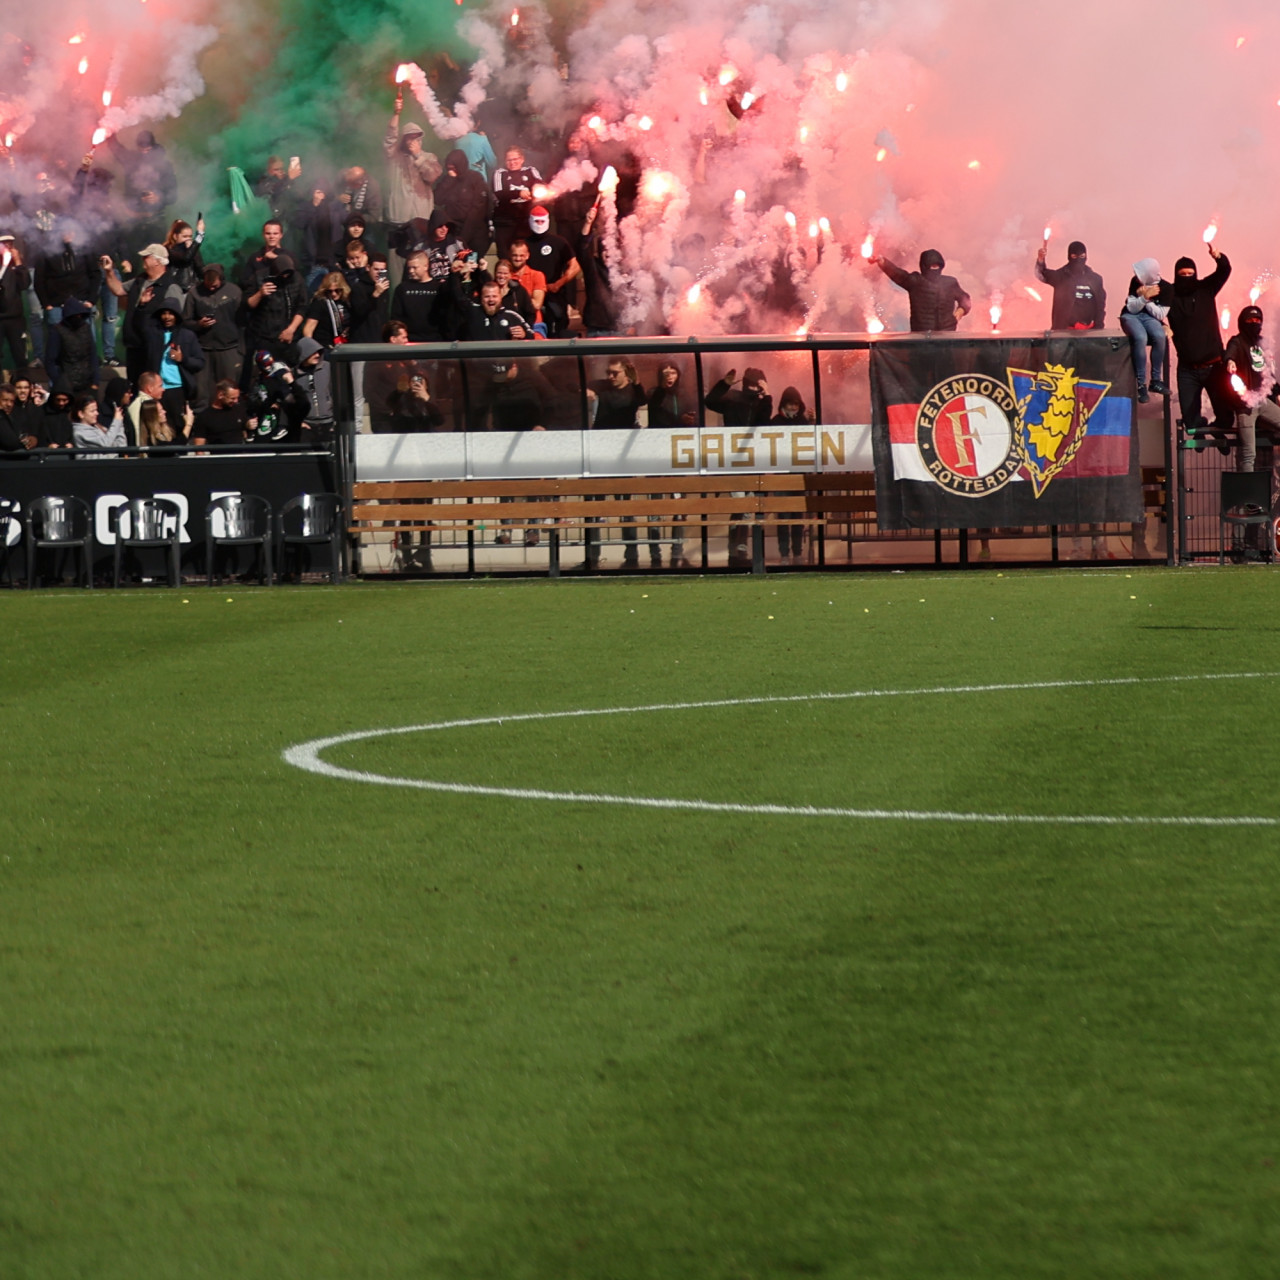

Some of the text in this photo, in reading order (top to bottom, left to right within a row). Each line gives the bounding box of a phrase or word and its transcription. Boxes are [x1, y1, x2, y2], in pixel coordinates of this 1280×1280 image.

[920, 379, 1015, 428] FEYENOORD
[671, 431, 846, 469] GASTEN
[946, 406, 987, 468] F
